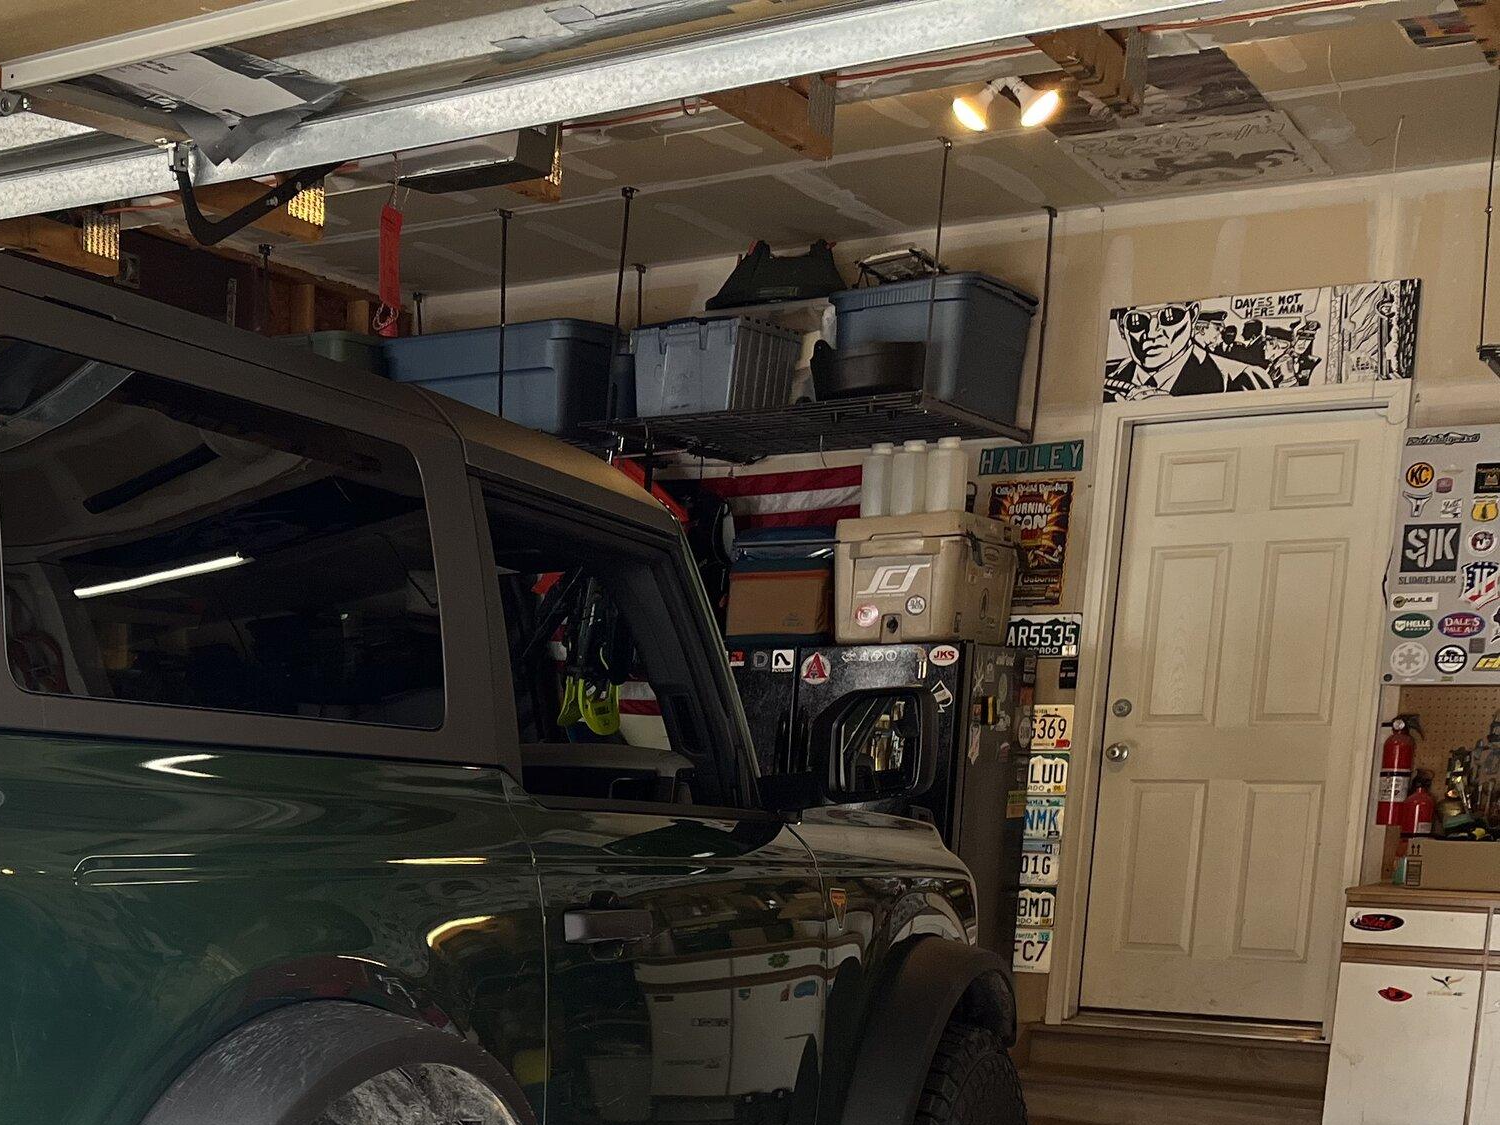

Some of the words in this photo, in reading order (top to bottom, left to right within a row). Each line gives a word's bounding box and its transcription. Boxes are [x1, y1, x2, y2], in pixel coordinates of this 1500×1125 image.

[1235, 296, 1273, 309] DAVES
[1245, 306, 1275, 319] HERE
[1278, 304, 1303, 315] MAN
[982, 443, 1082, 475] HADLEY
[1410, 465, 1430, 485] KC
[1009, 502, 1052, 515] BURNING
[1006, 625, 1077, 647] AR5535
[934, 650, 955, 660] JKS
